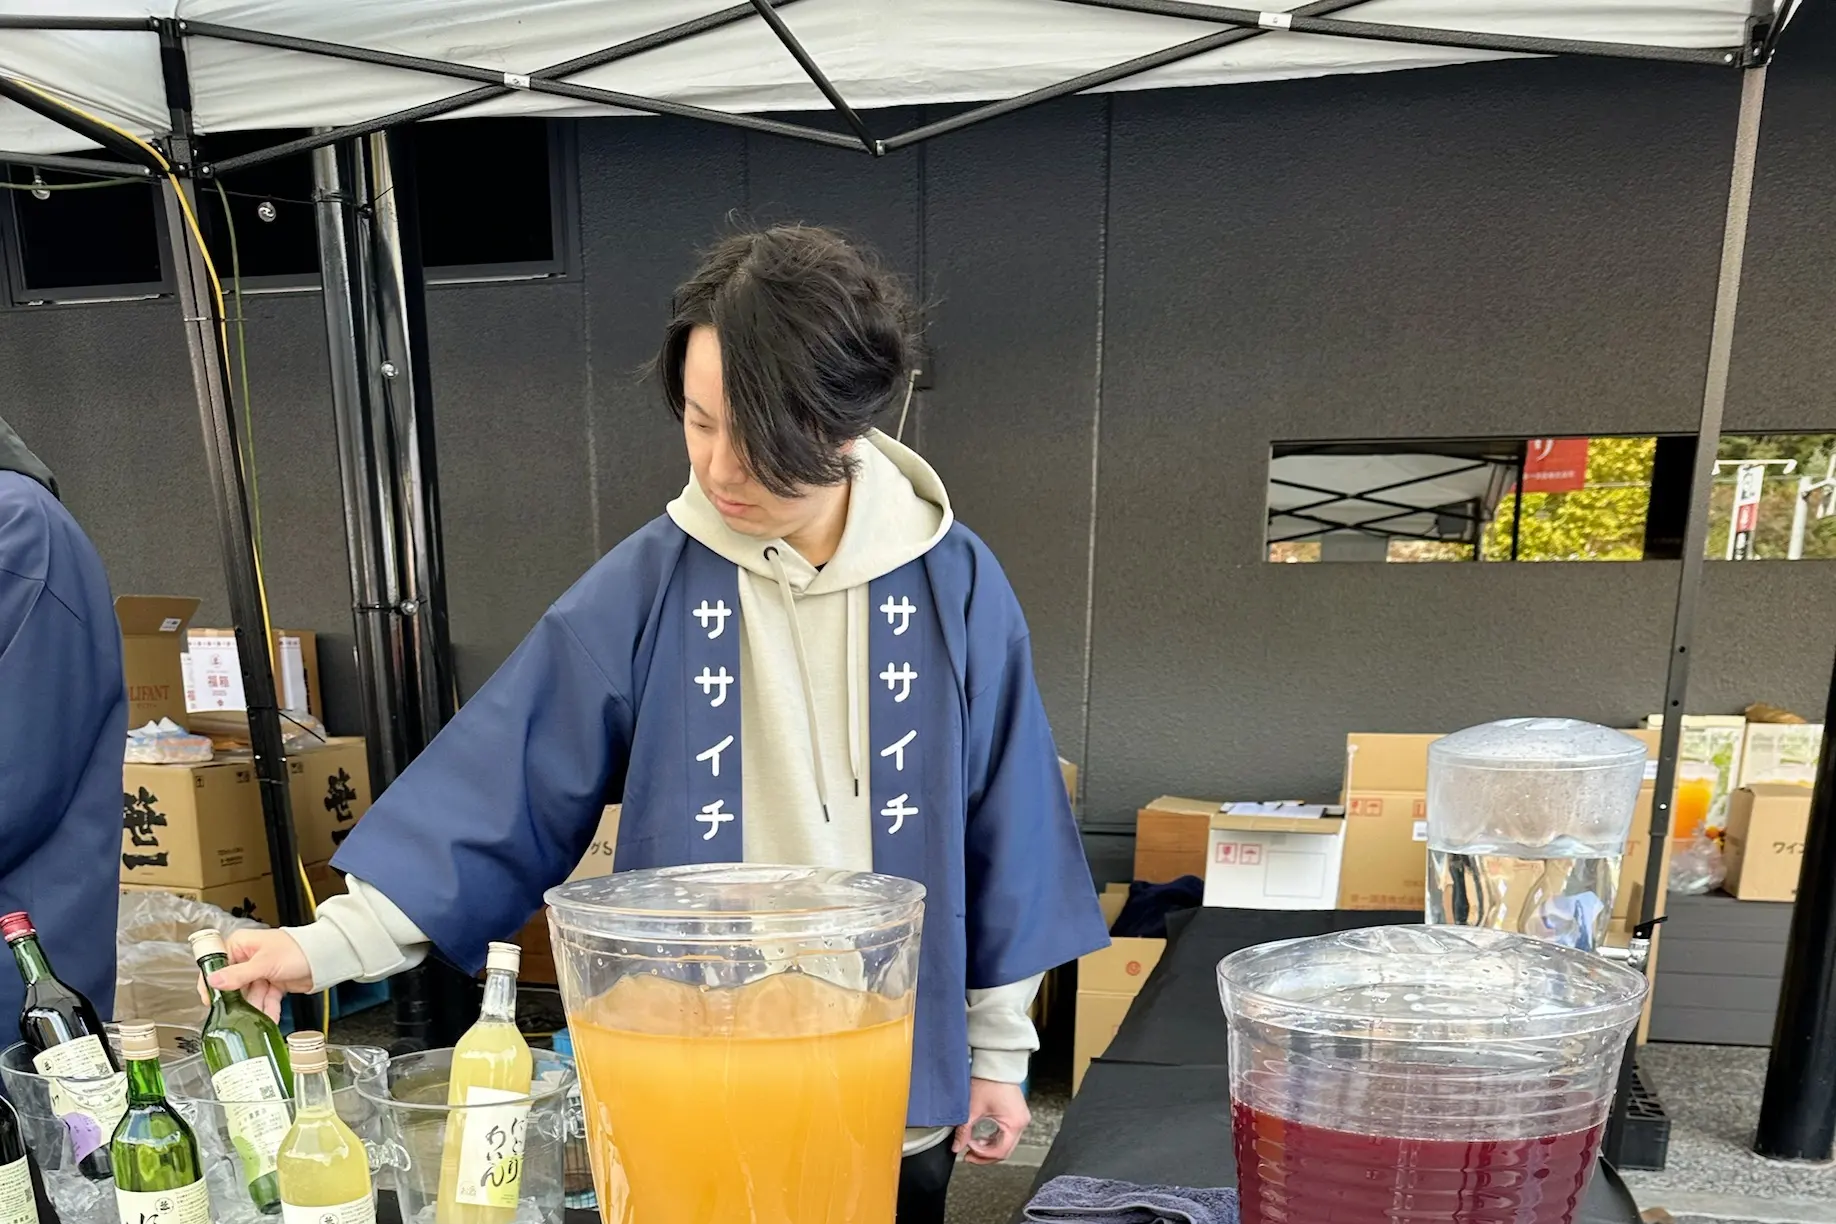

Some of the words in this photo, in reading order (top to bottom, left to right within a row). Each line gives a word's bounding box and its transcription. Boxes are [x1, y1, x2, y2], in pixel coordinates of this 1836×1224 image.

[129, 685, 170, 701] LIFANT
[693, 599, 734, 840] ササイチ
[880, 596, 918, 834] ササイチ
[480, 1125, 506, 1187] わいん
